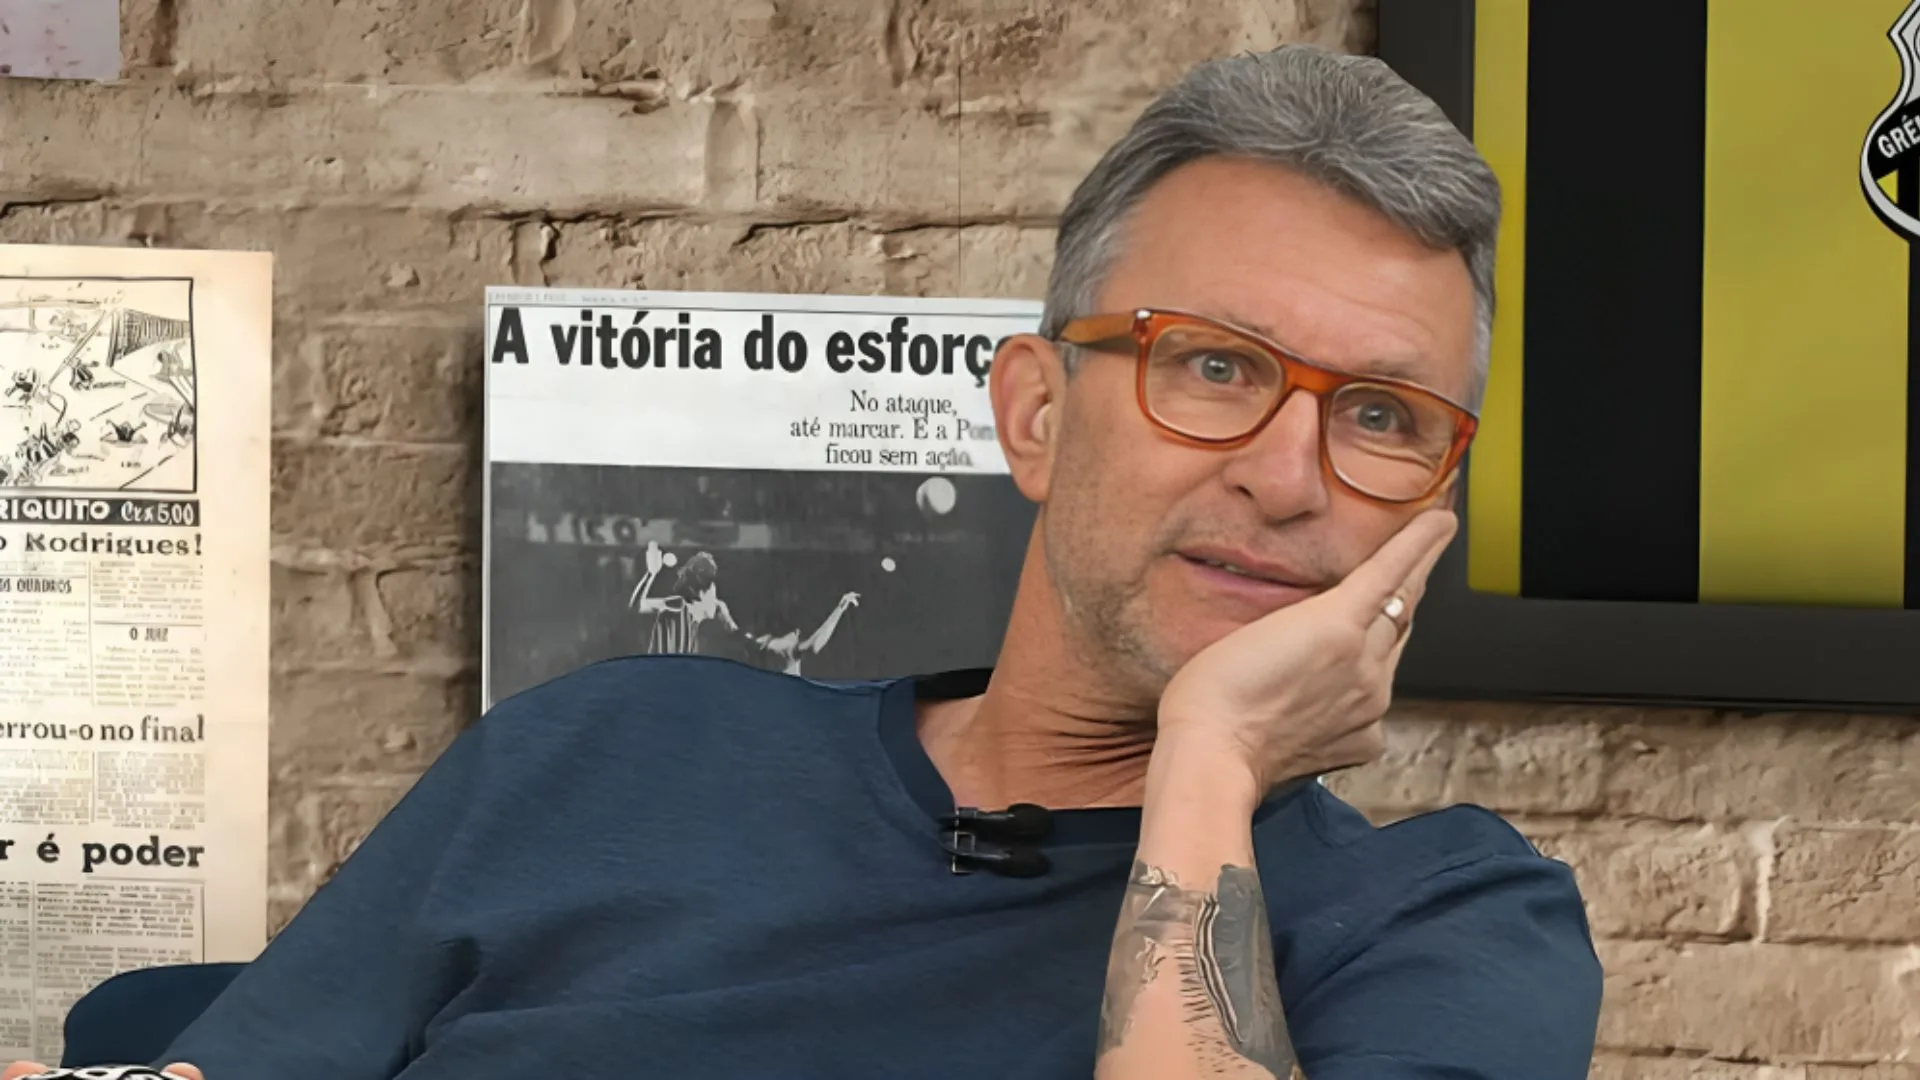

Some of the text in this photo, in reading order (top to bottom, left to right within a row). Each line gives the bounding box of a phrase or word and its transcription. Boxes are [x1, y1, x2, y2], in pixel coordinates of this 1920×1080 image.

[492, 307, 1010, 388] A vitória do esforç
[850, 390, 958, 417] No ataque,
[790, 417, 821, 437] até
[829, 422, 904, 439] marcar.
[936, 424, 948, 440] a
[826, 444, 872, 464] ficou
[879, 448, 917, 465] sem
[100, 722, 134, 742] no
[141, 714, 205, 742] final
[37, 833, 60, 863] é
[82, 835, 205, 873] poder
